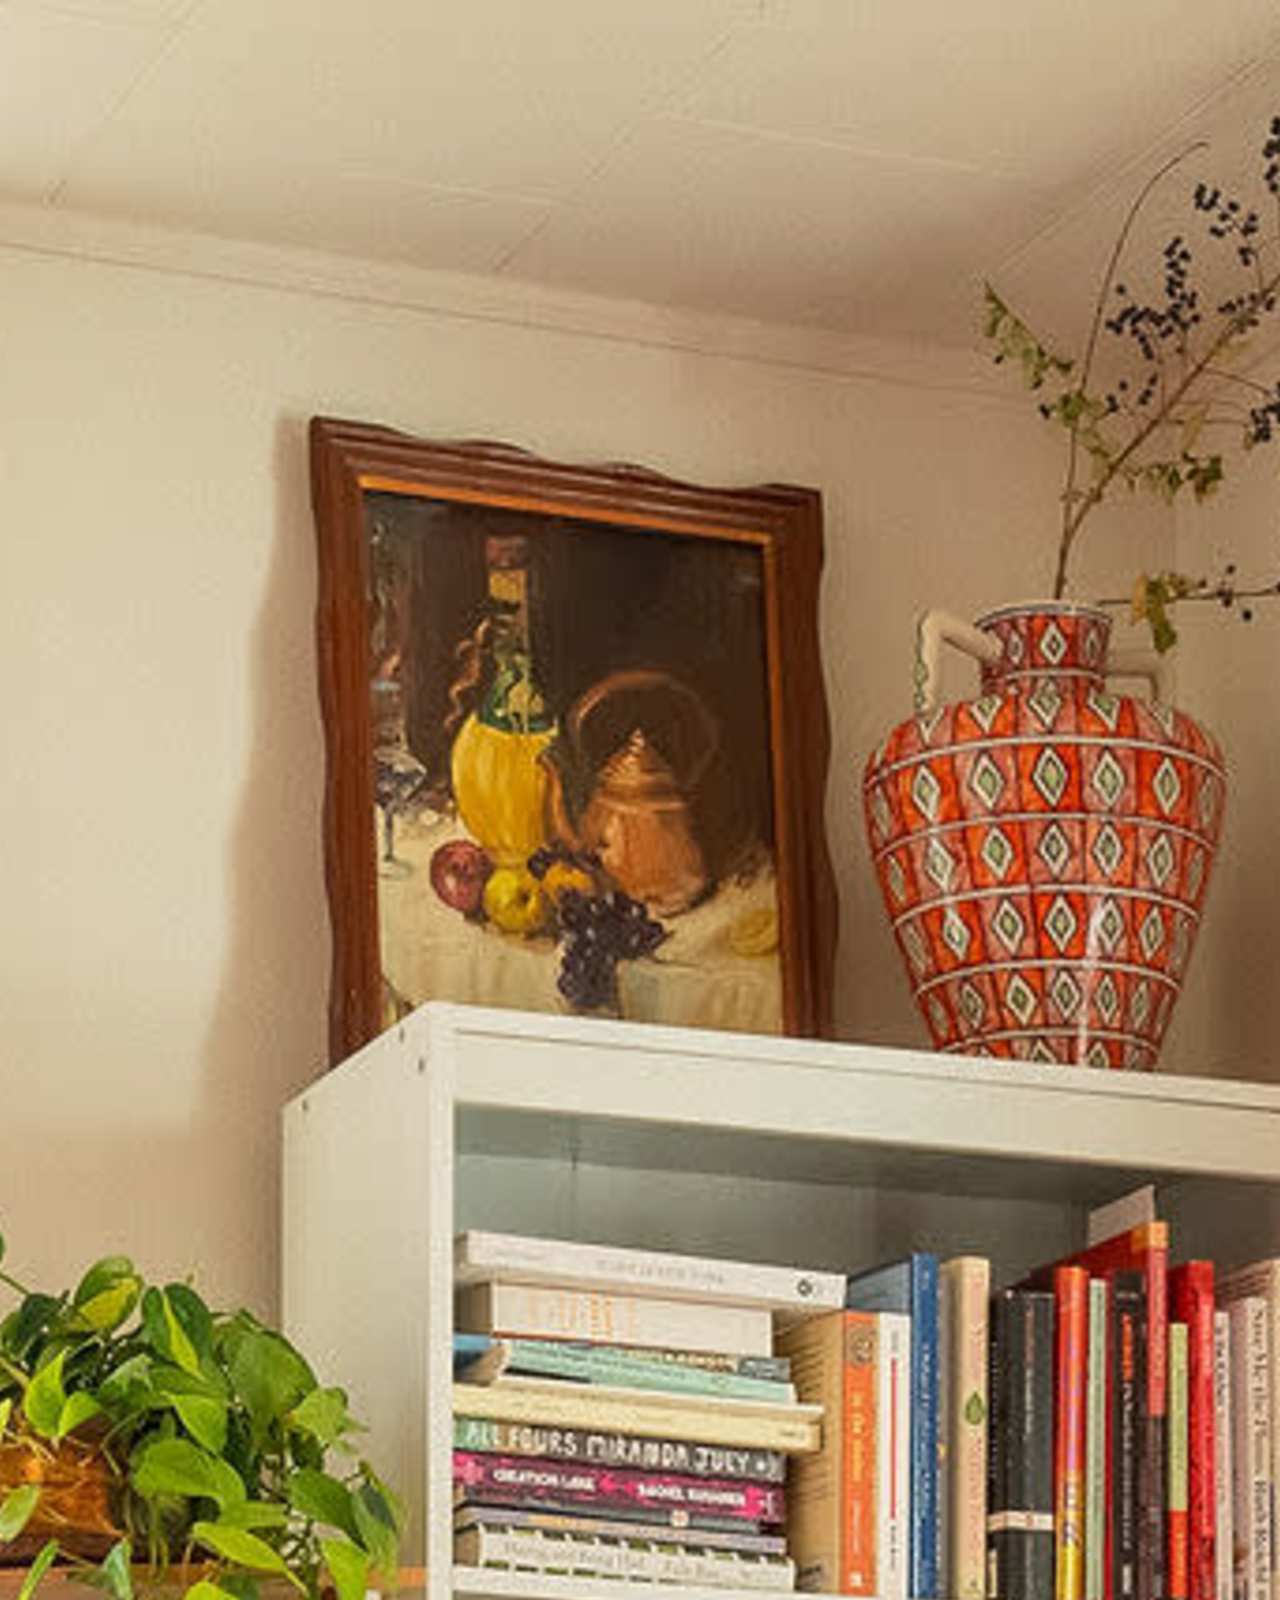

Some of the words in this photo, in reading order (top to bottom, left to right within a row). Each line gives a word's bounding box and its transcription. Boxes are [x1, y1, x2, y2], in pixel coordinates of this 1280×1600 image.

[508, 1428, 580, 1460] FOURS
[586, 1434, 692, 1472] MIRANDA
[695, 1449, 751, 1477] JULY
